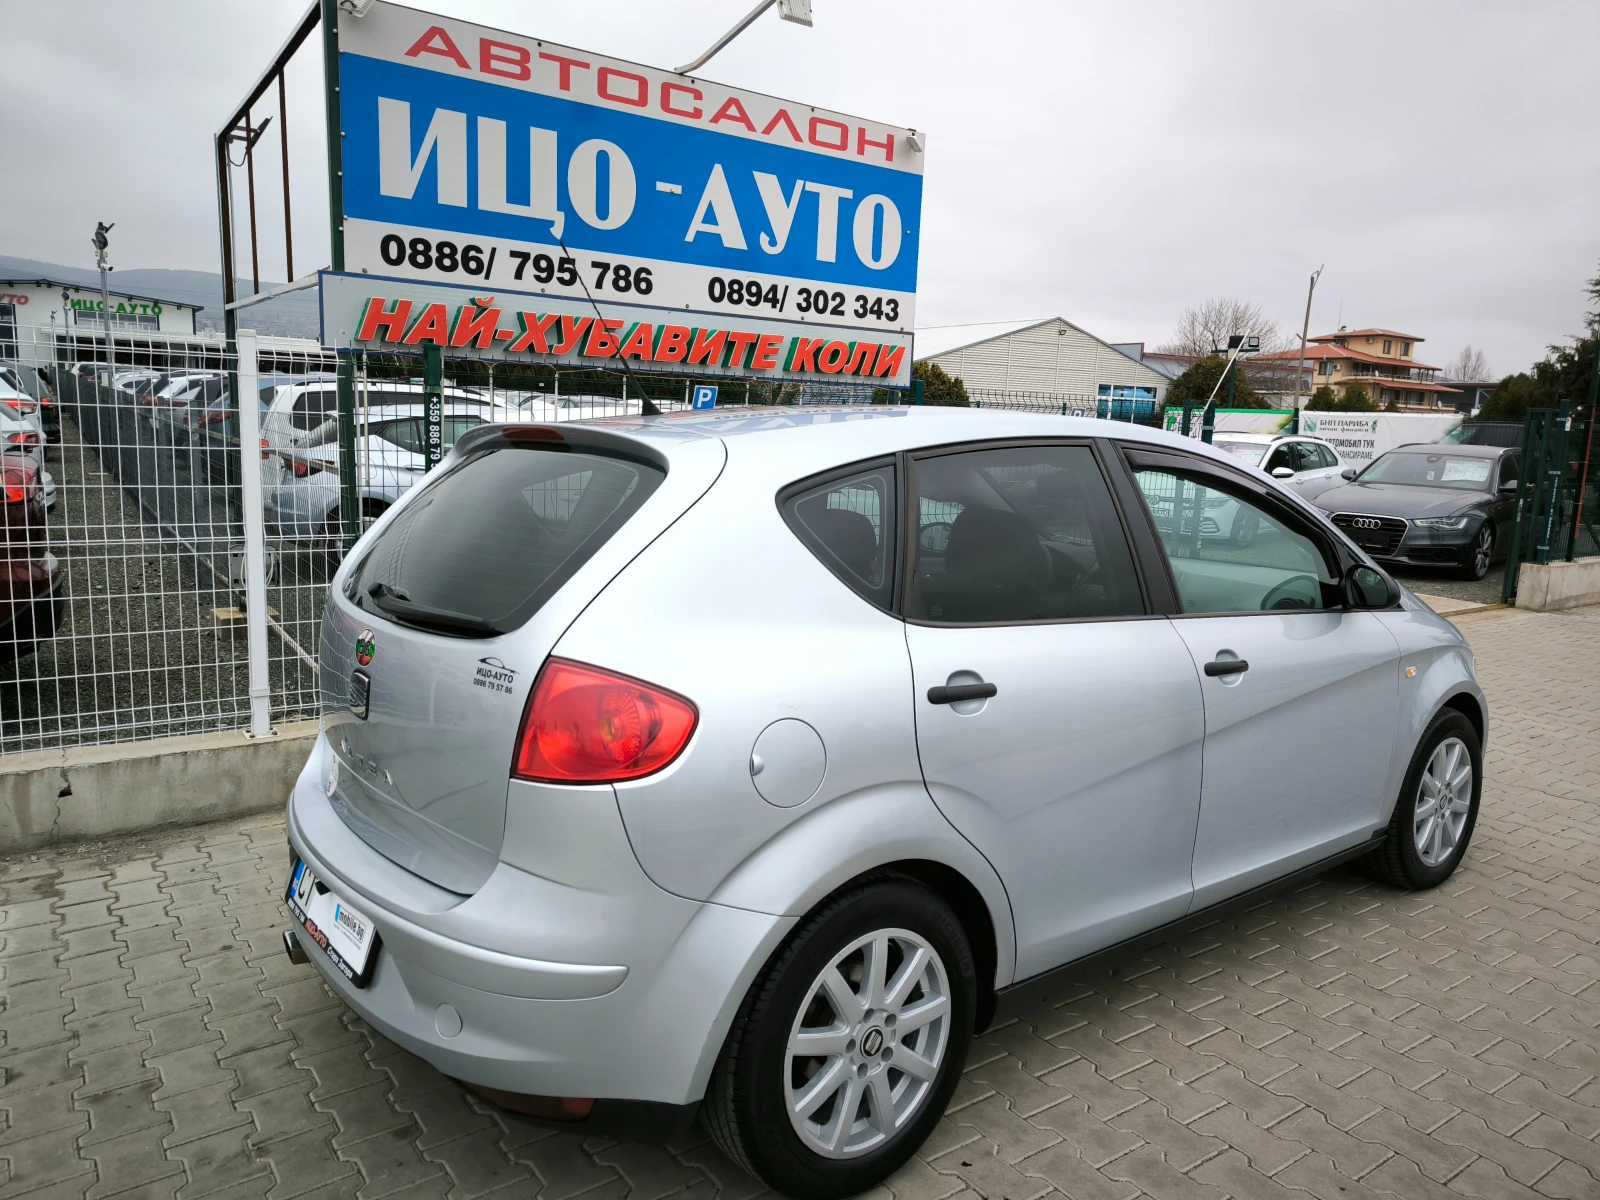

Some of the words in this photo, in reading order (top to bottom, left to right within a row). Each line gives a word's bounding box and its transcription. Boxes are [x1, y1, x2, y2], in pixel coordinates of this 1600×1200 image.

[404, 25, 895, 162] АВТОСАЛОН
[377, 96, 637, 240] ИЦО
[380, 234, 496, 280] 0886/
[509, 249, 578, 287] 795
[590, 260, 654, 296] 786
[707, 276, 789, 313] 0894/
[797, 287, 845, 317] 302
[854, 293, 900, 323] 343
[355, 295, 784, 371] НАЙ-ХУБАВИТЕ
[784, 337, 906, 379] КОЛИ
[429, 396, 440, 422] +359
[697, 389, 712, 408] P
[429, 425, 440, 444] 886
[430, 447, 440, 460] 79
[476, 667, 514, 683] ИЦО-АУТО
[488, 681, 495, 690] 79
[496, 683, 504, 692] 57
[504, 686, 513, 695] 86
[339, 909, 366, 941] mobile.bg
